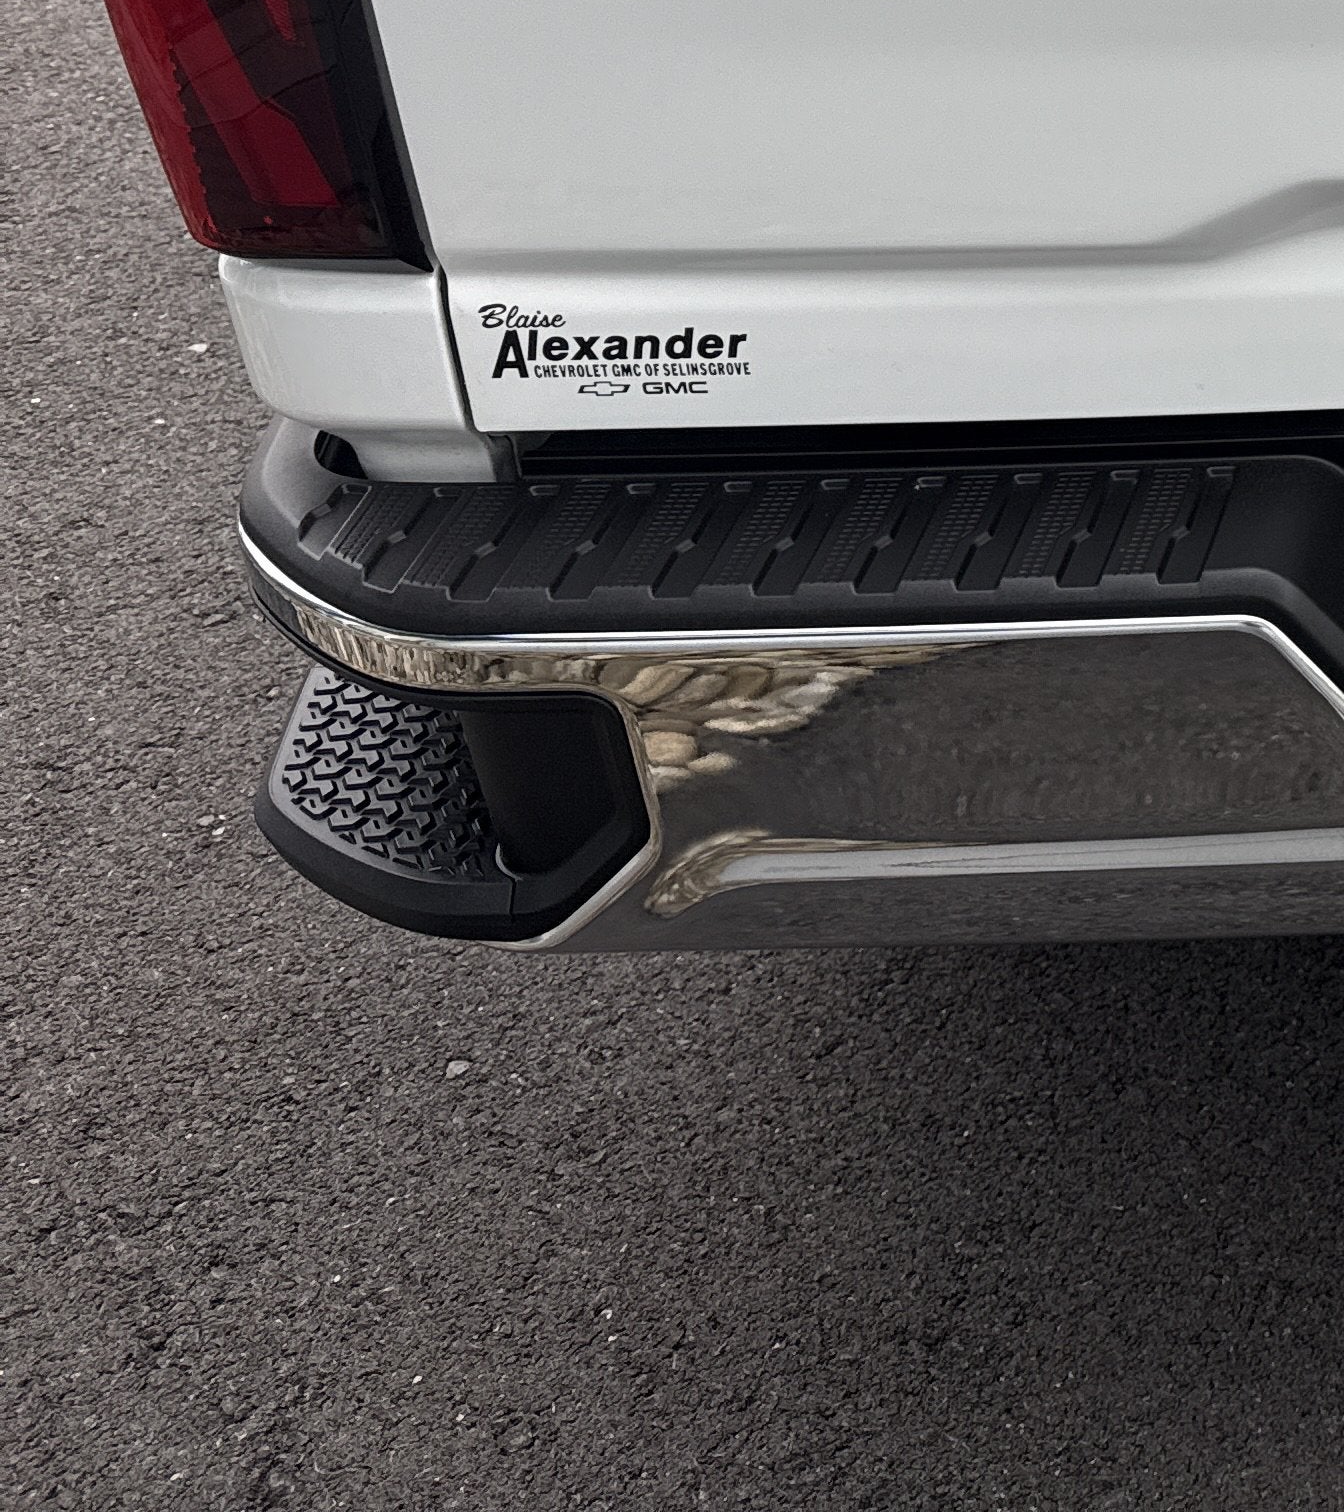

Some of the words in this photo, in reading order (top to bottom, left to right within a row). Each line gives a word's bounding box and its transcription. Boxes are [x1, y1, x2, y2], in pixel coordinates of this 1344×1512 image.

[478, 303, 566, 329] Blaise
[491, 327, 748, 379] Alexander
[533, 363, 608, 379] CHEVROLET
[611, 363, 642, 378] GMC
[644, 363, 661, 377] OF
[662, 361, 752, 377] SELINSGROVE
[642, 381, 709, 395] GMC
